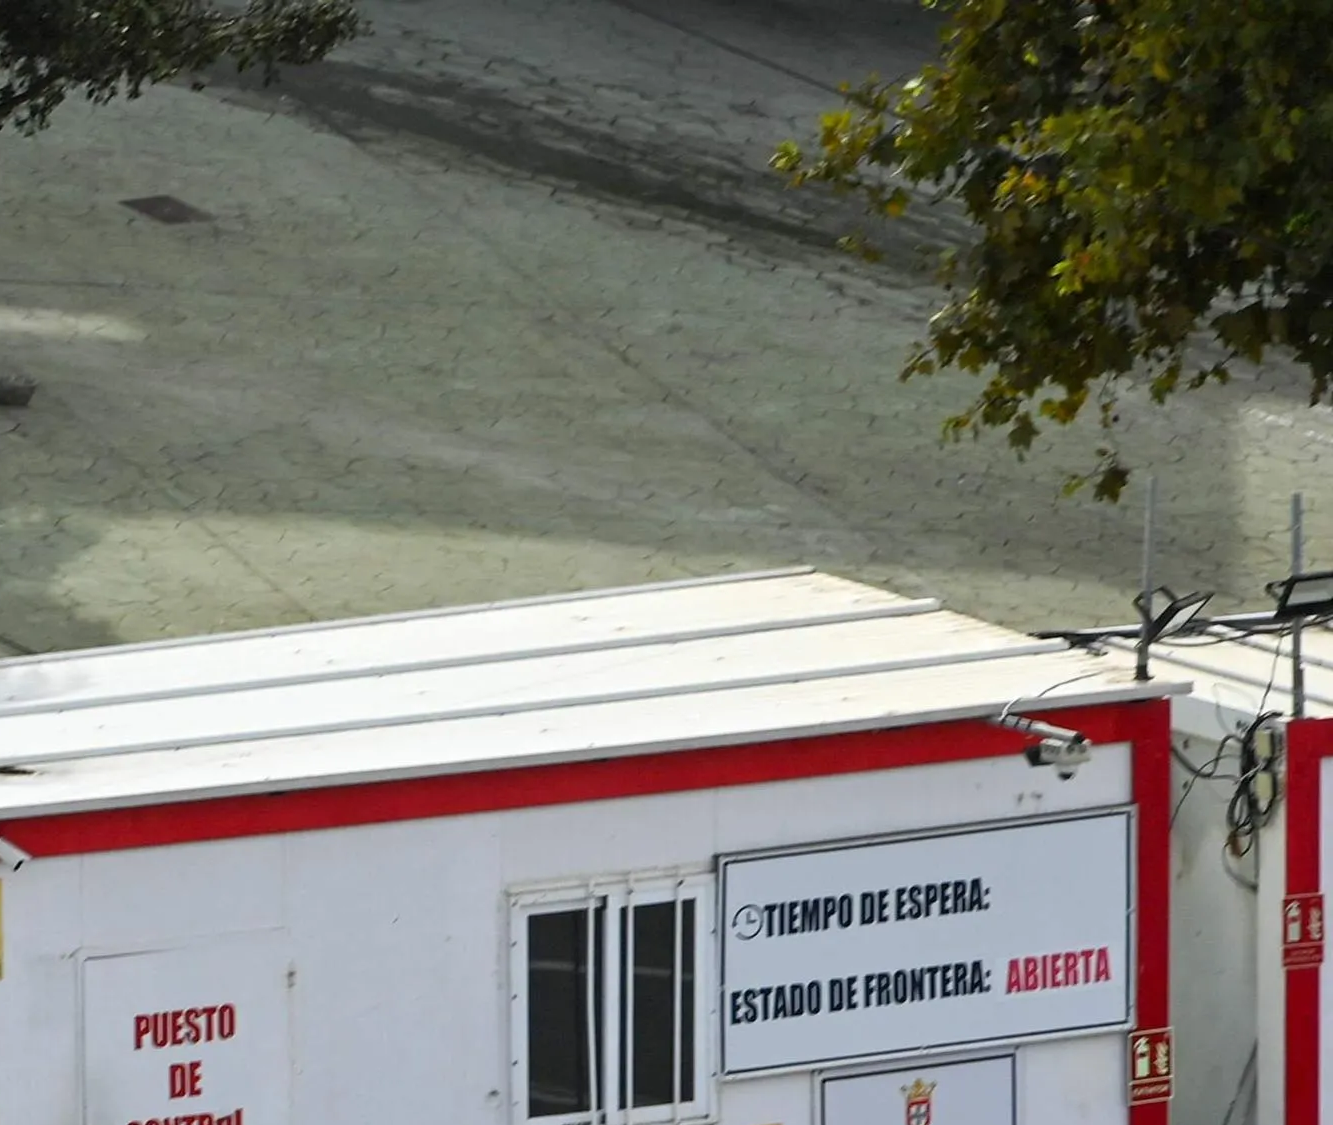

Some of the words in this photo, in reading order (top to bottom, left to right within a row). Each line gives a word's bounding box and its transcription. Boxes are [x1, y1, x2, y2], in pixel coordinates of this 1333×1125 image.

[764, 892, 853, 938] TIEMPO
[859, 888, 889, 926] DE
[895, 877, 991, 921] ESPERA:
[730, 979, 823, 1025] ESTADO
[828, 975, 858, 1013] DE
[864, 959, 992, 1009] FRONTERA:
[1004, 945, 1112, 996] ABIERTA
[133, 1002, 236, 1050] PUESTO
[168, 1060, 203, 1100] DE
